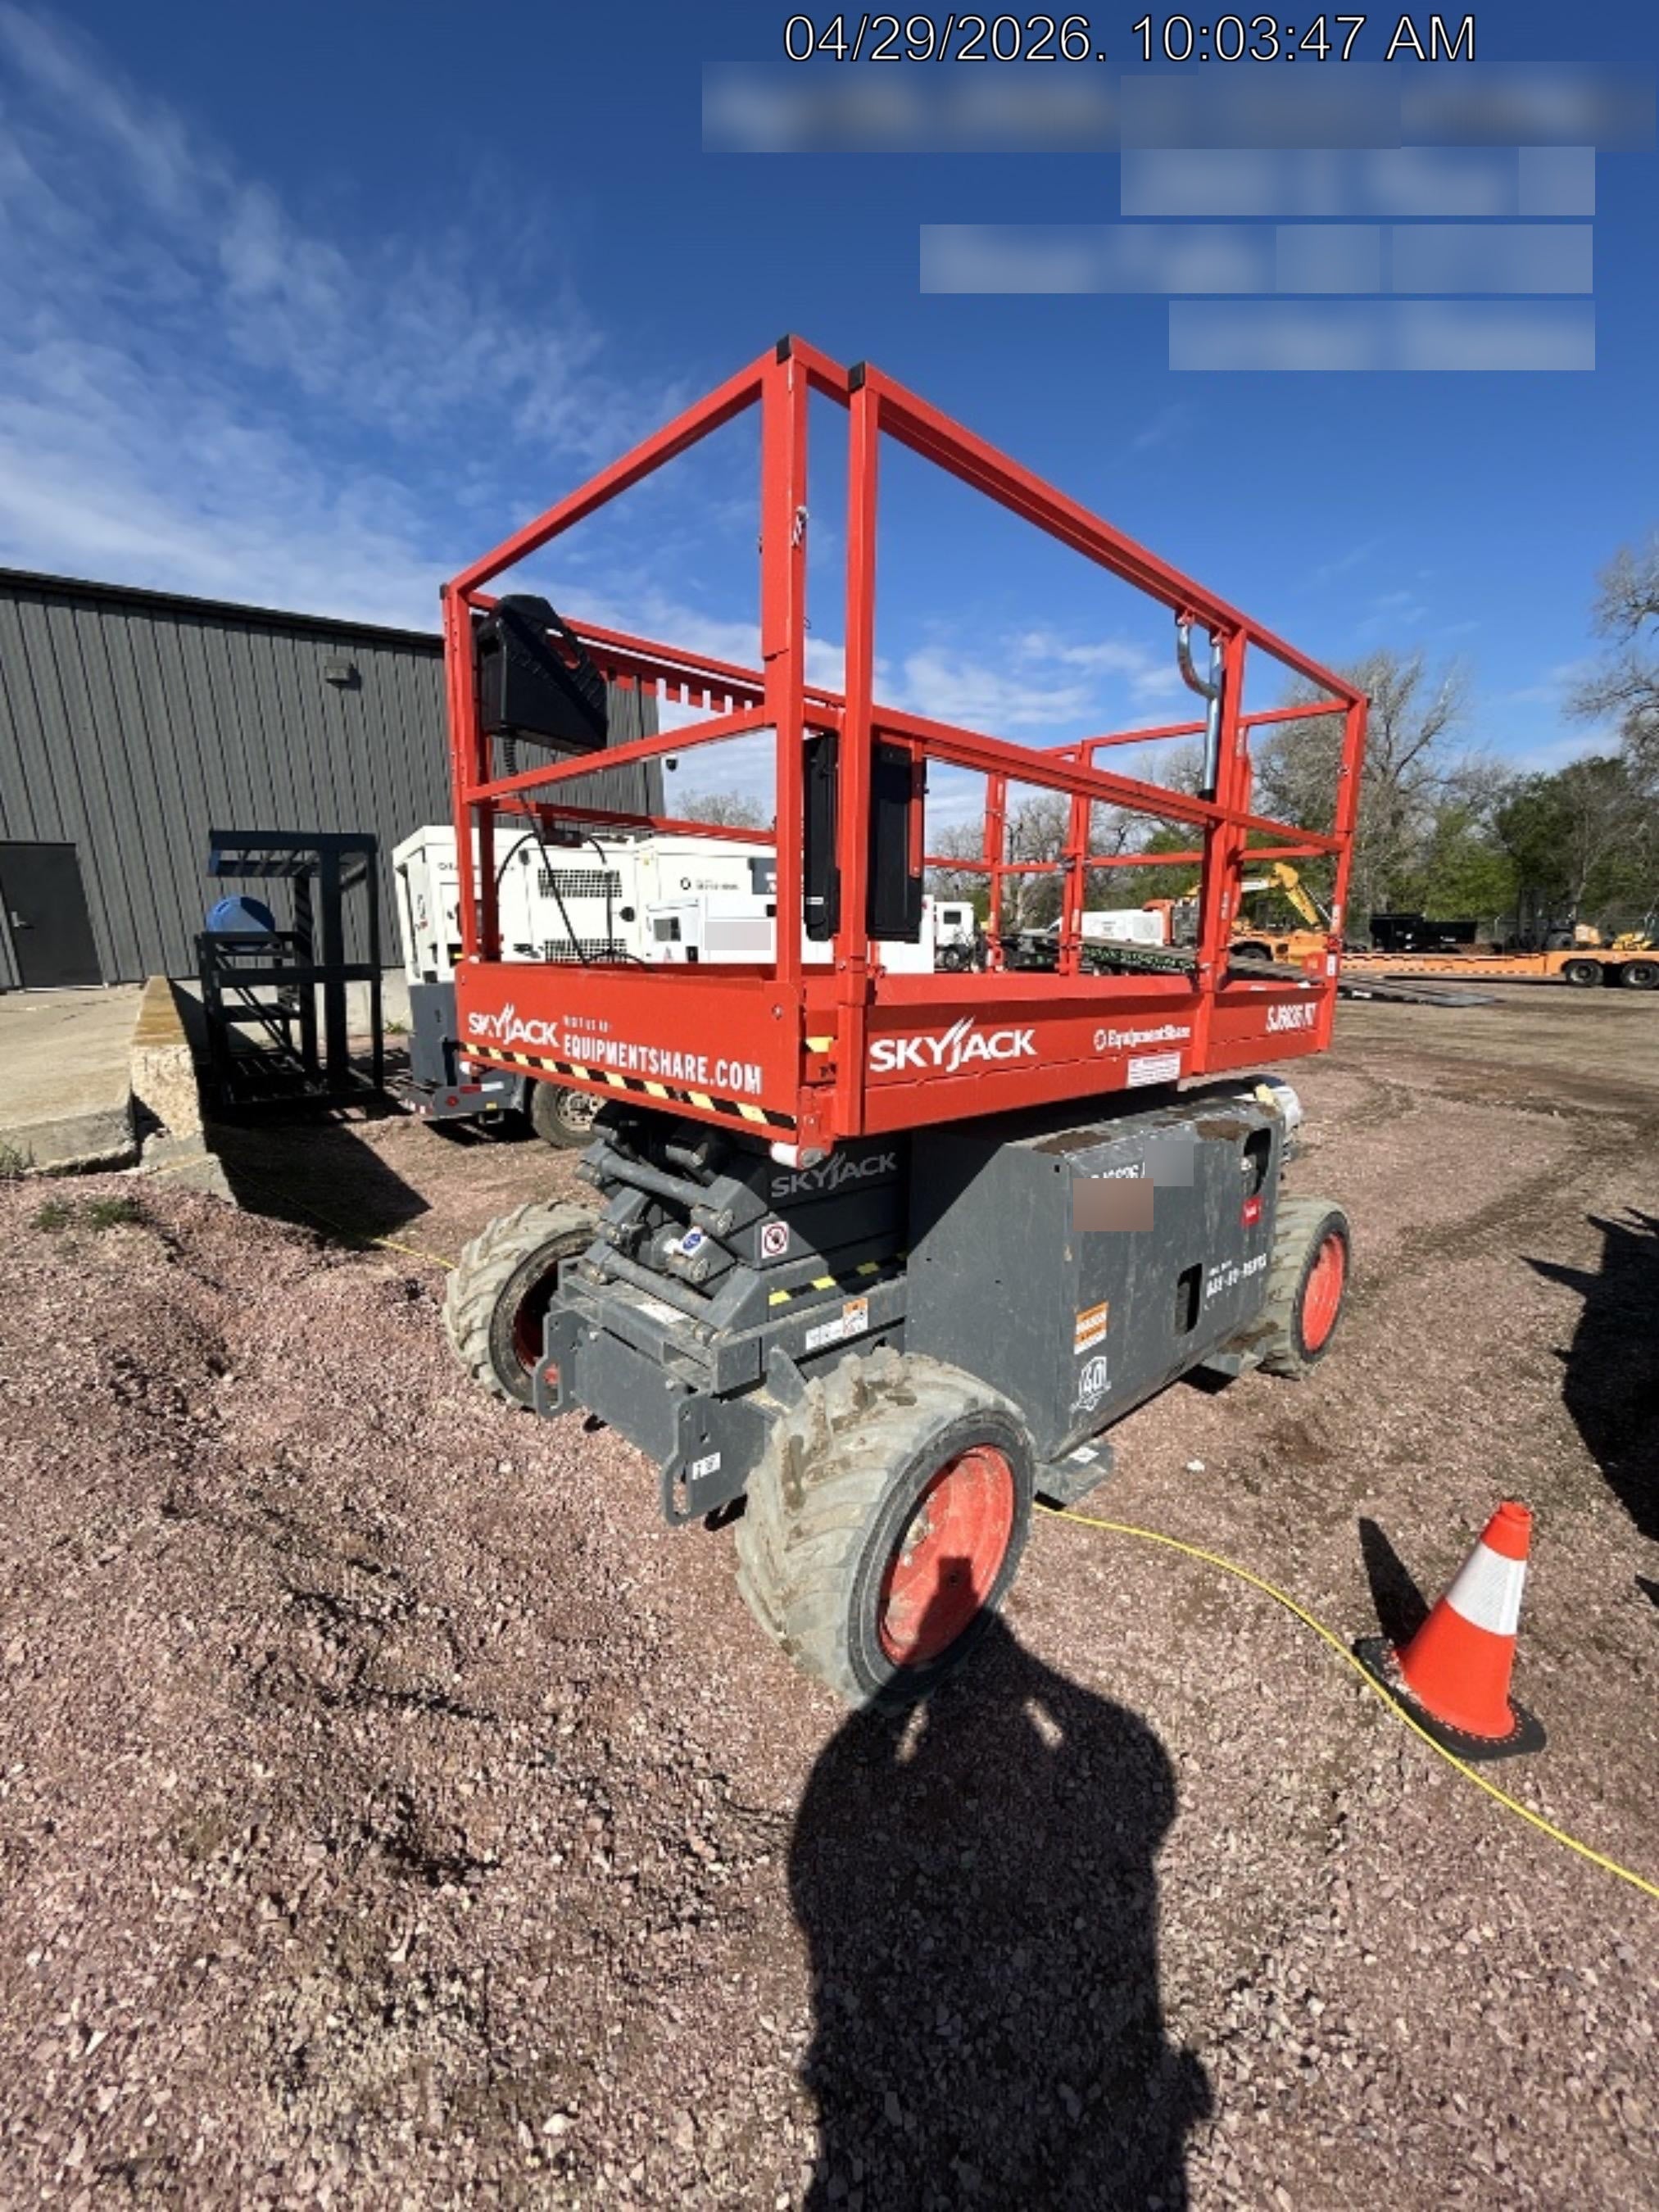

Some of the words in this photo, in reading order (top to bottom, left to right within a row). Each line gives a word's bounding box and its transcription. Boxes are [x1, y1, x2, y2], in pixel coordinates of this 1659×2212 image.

[468, 1002, 560, 1048] SKYJACK
[869, 1016, 1037, 1072] SKYJACK
[564, 1034, 763, 1095] EQUIPMENTSHARE.COM
[771, 1151, 897, 1198] SKYJACK
